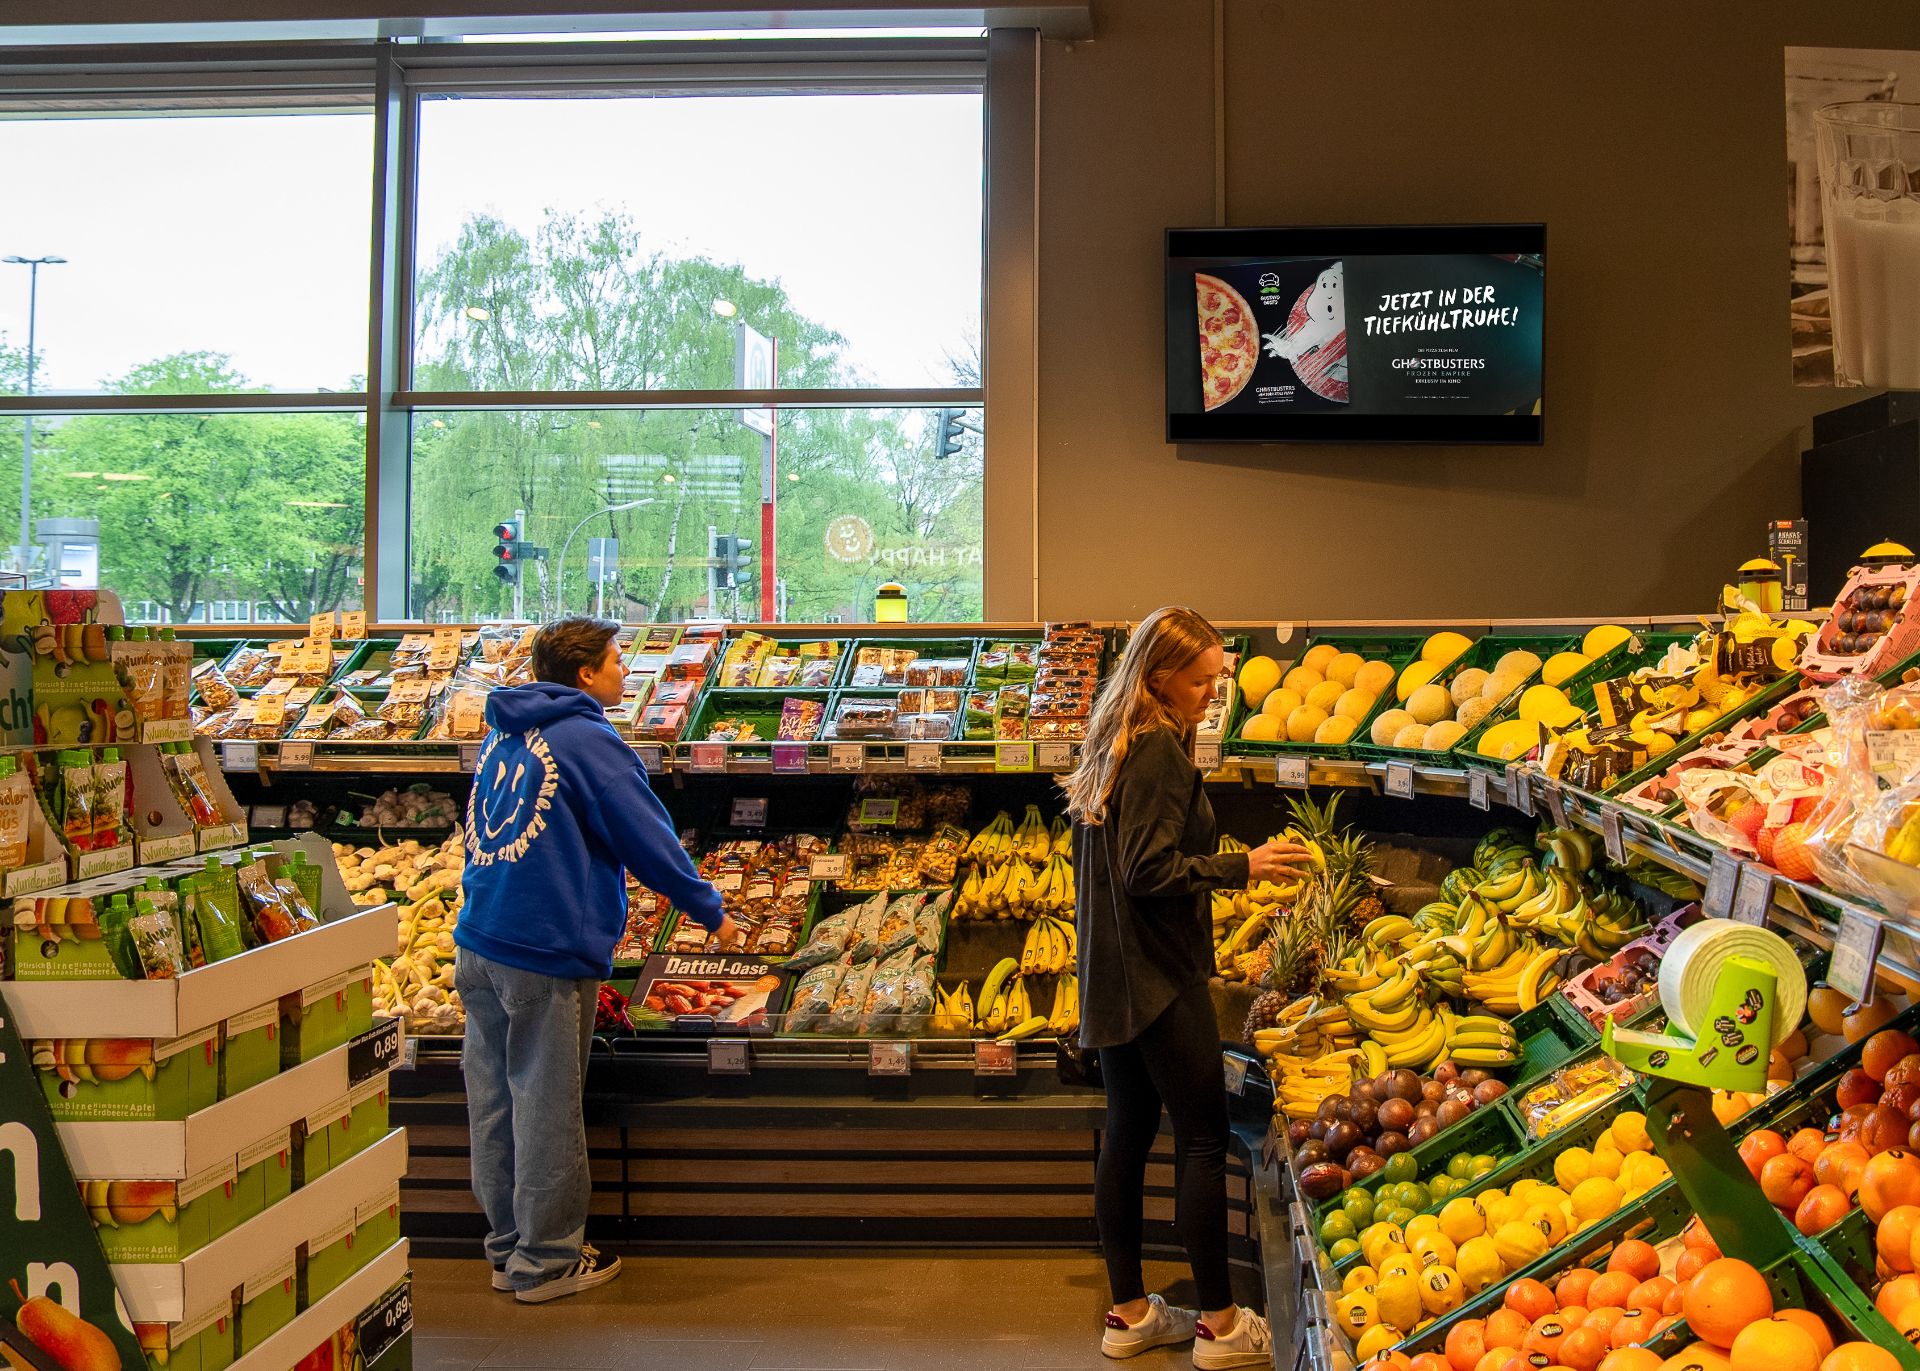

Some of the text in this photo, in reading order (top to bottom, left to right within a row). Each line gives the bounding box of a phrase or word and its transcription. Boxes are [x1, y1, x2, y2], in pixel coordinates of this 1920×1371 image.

[1379, 285, 1495, 312] JETZT IN DER
[1364, 306, 1519, 336] TIEFKÜHLTRUHE!
[1013, 755, 1029, 763] 2,29
[1053, 755, 1070, 763] 2,49
[1198, 756, 1218, 764] 12,99
[1290, 771, 1305, 780] 3,99
[142, 841, 178, 861] Wunder
[81, 853, 115, 877] Wunder
[8, 869, 47, 895] Wunder
[46, 962, 74, 970] Birne
[664, 957, 769, 976] Dattel-Oase
[74, 968, 111, 976] Erdbeere
[374, 1032, 398, 1059] 0,89
[726, 1057, 745, 1066] 1,29
[888, 1057, 906, 1066] 1,49
[994, 1057, 1012, 1066] 1,79
[65, 1102, 93, 1110] Birne
[130, 1103, 155, 1112] Apfel
[151, 1245, 177, 1254] Apfel
[113, 1252, 150, 1260] Erdbeere
[386, 1296, 408, 1327] 0,89
